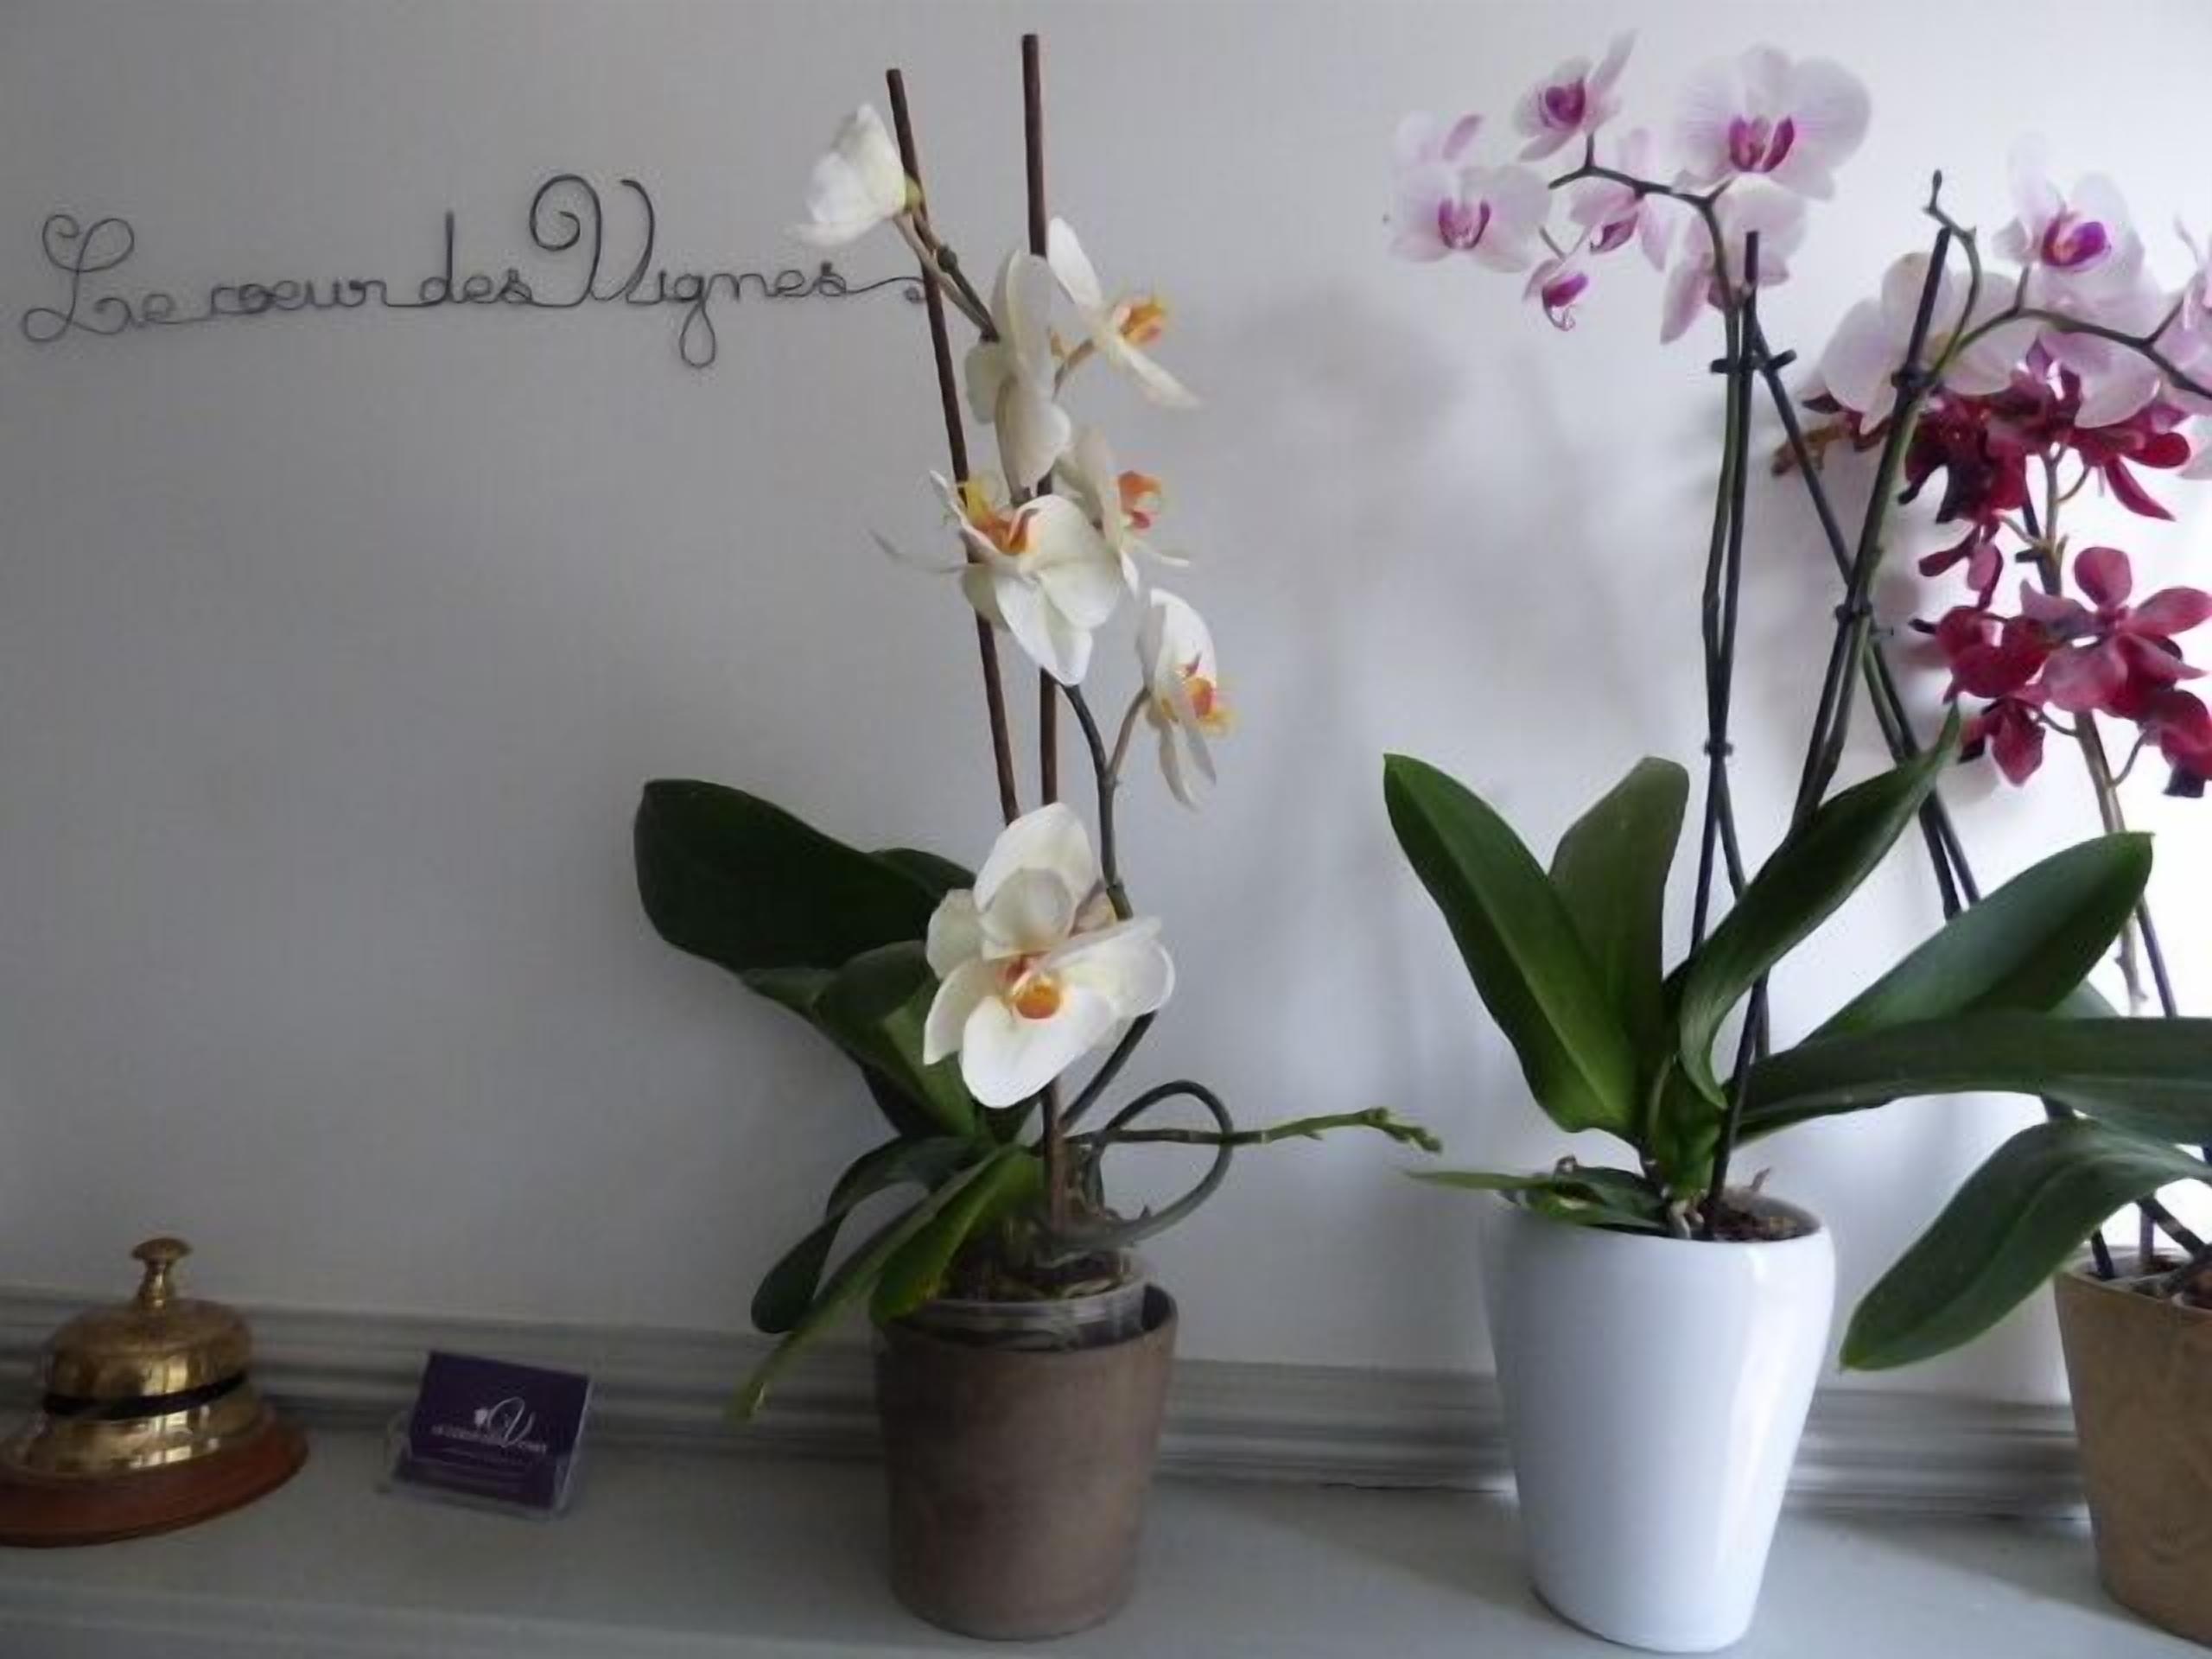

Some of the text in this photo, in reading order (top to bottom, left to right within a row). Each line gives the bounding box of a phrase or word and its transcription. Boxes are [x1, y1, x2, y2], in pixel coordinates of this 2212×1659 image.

[22, 213, 178, 343] Le
[418, 210, 533, 308] des
[529, 174, 850, 368] Vignes
